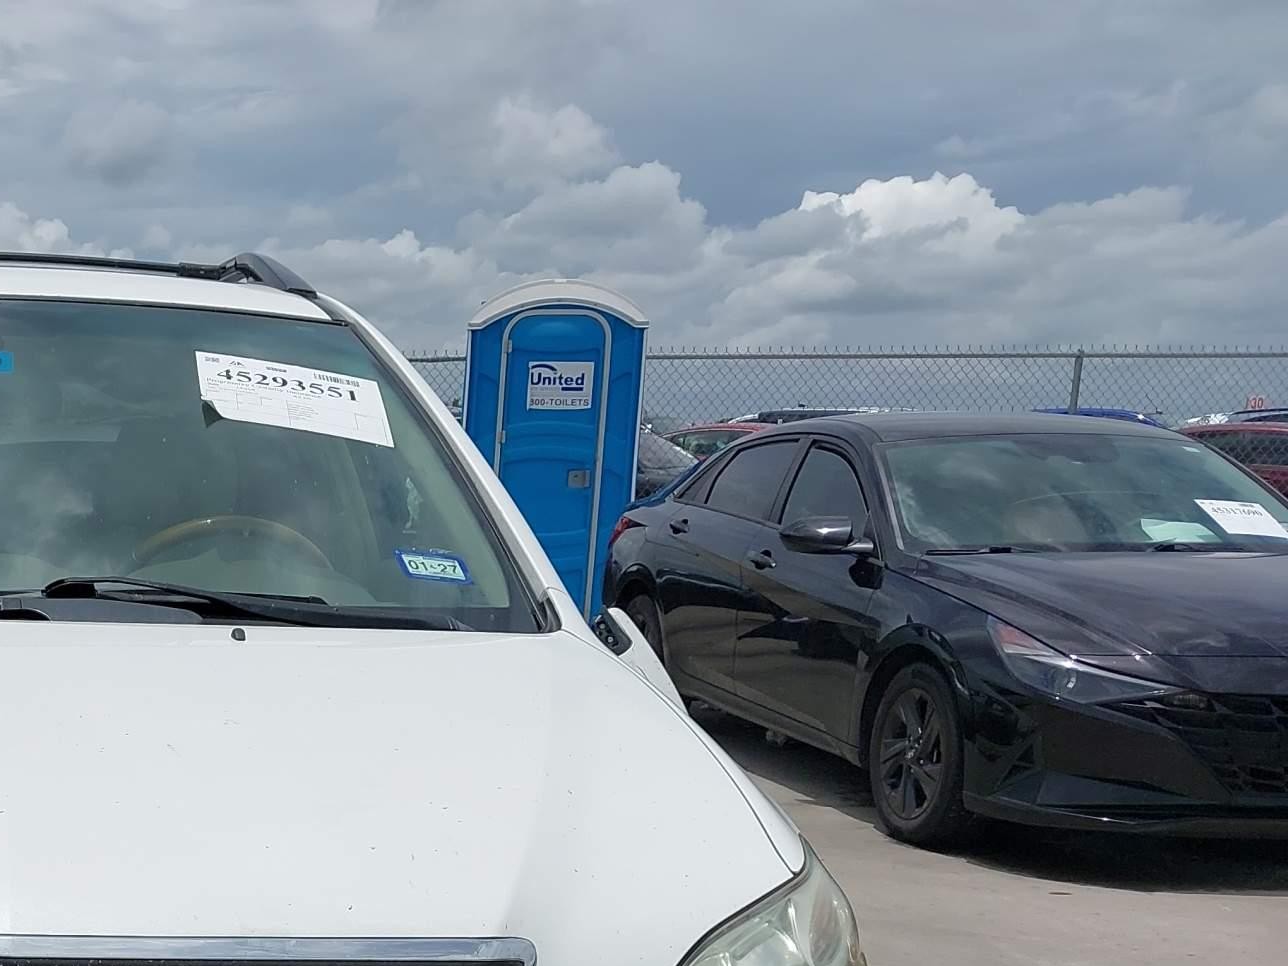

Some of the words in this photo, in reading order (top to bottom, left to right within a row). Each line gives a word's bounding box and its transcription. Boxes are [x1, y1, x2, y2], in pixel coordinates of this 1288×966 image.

[216, 368, 359, 402] 45293551
[530, 371, 585, 386] United
[408, 559, 458, 575] 01-27
